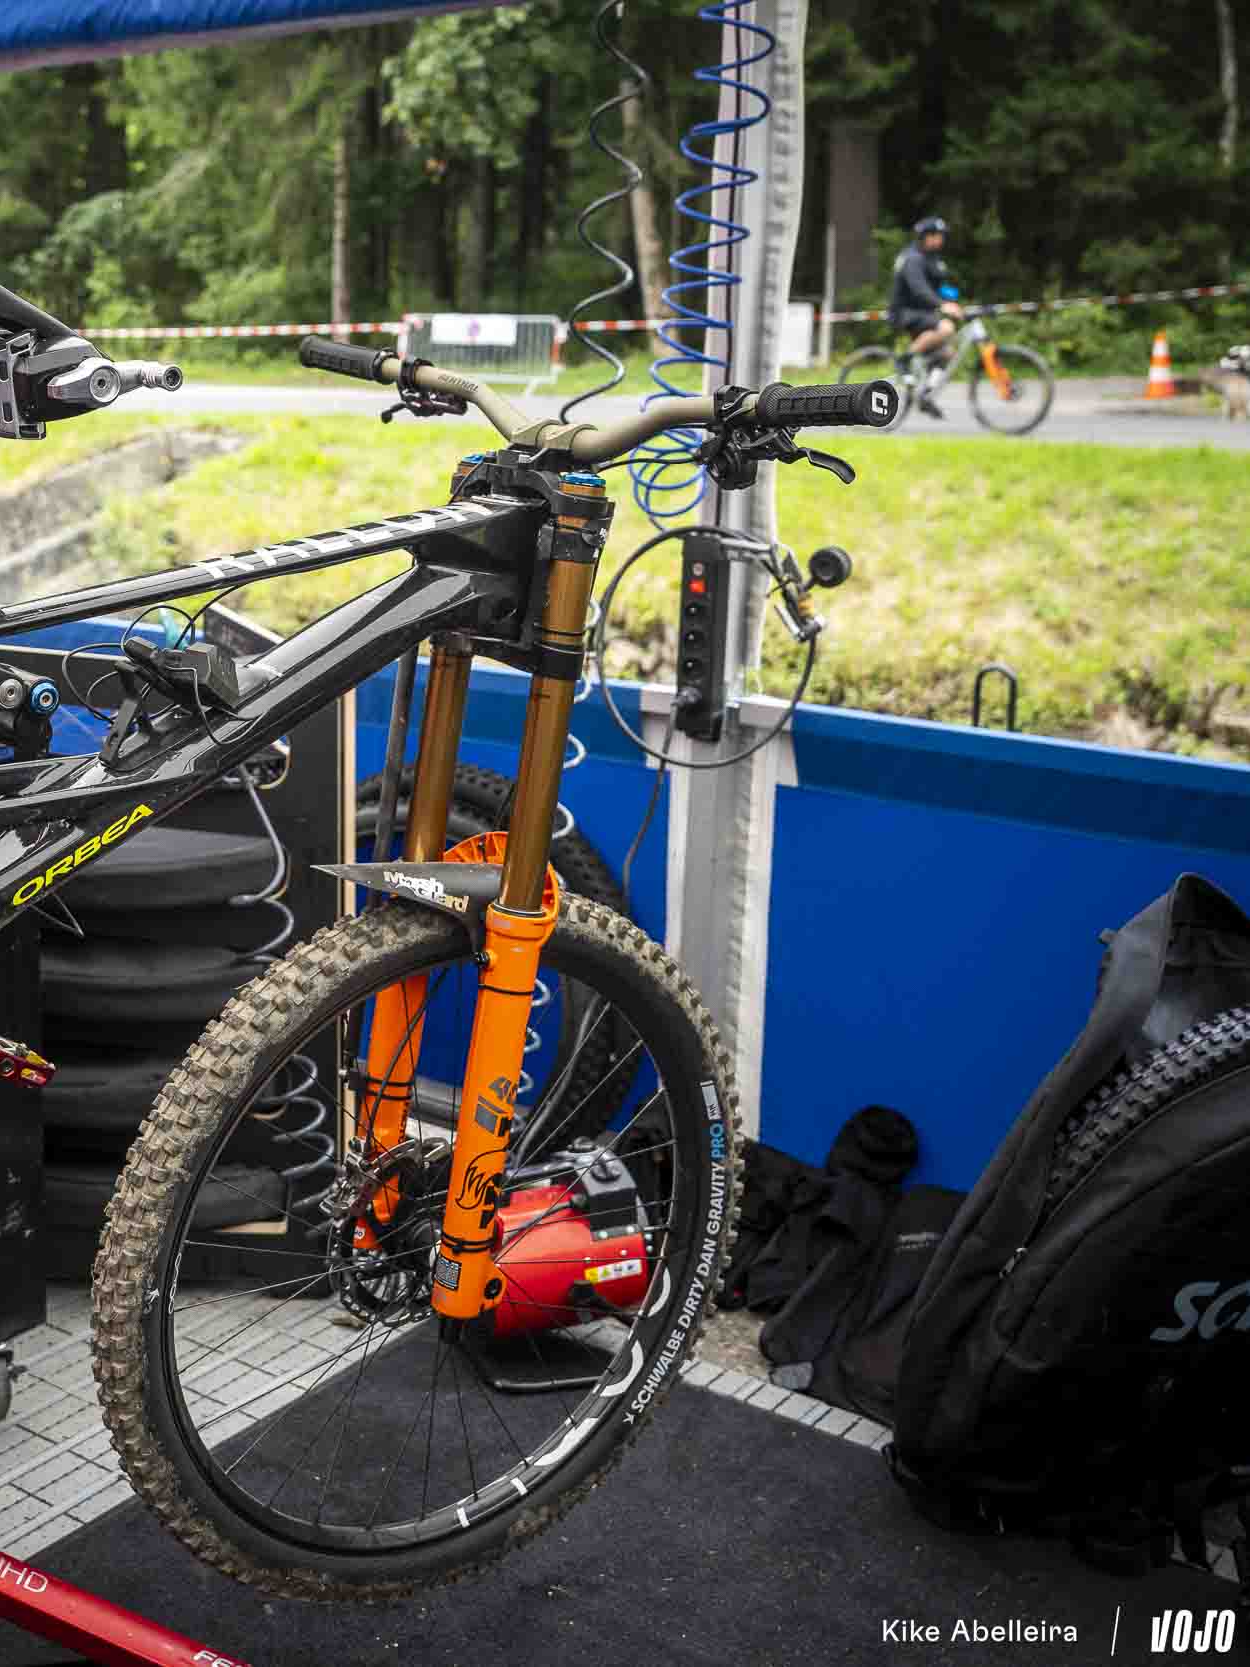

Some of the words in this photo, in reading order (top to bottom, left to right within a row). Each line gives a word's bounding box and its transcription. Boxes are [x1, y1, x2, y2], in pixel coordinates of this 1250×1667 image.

[12, 803, 155, 906] ORBEA
[709, 1122, 727, 1160] PRO
[706, 1160, 727, 1236] GRAVITY
[696, 1237, 717, 1279] DAN
[677, 1276, 705, 1330] DIRTY
[631, 1328, 686, 1414] SCHWALBE
